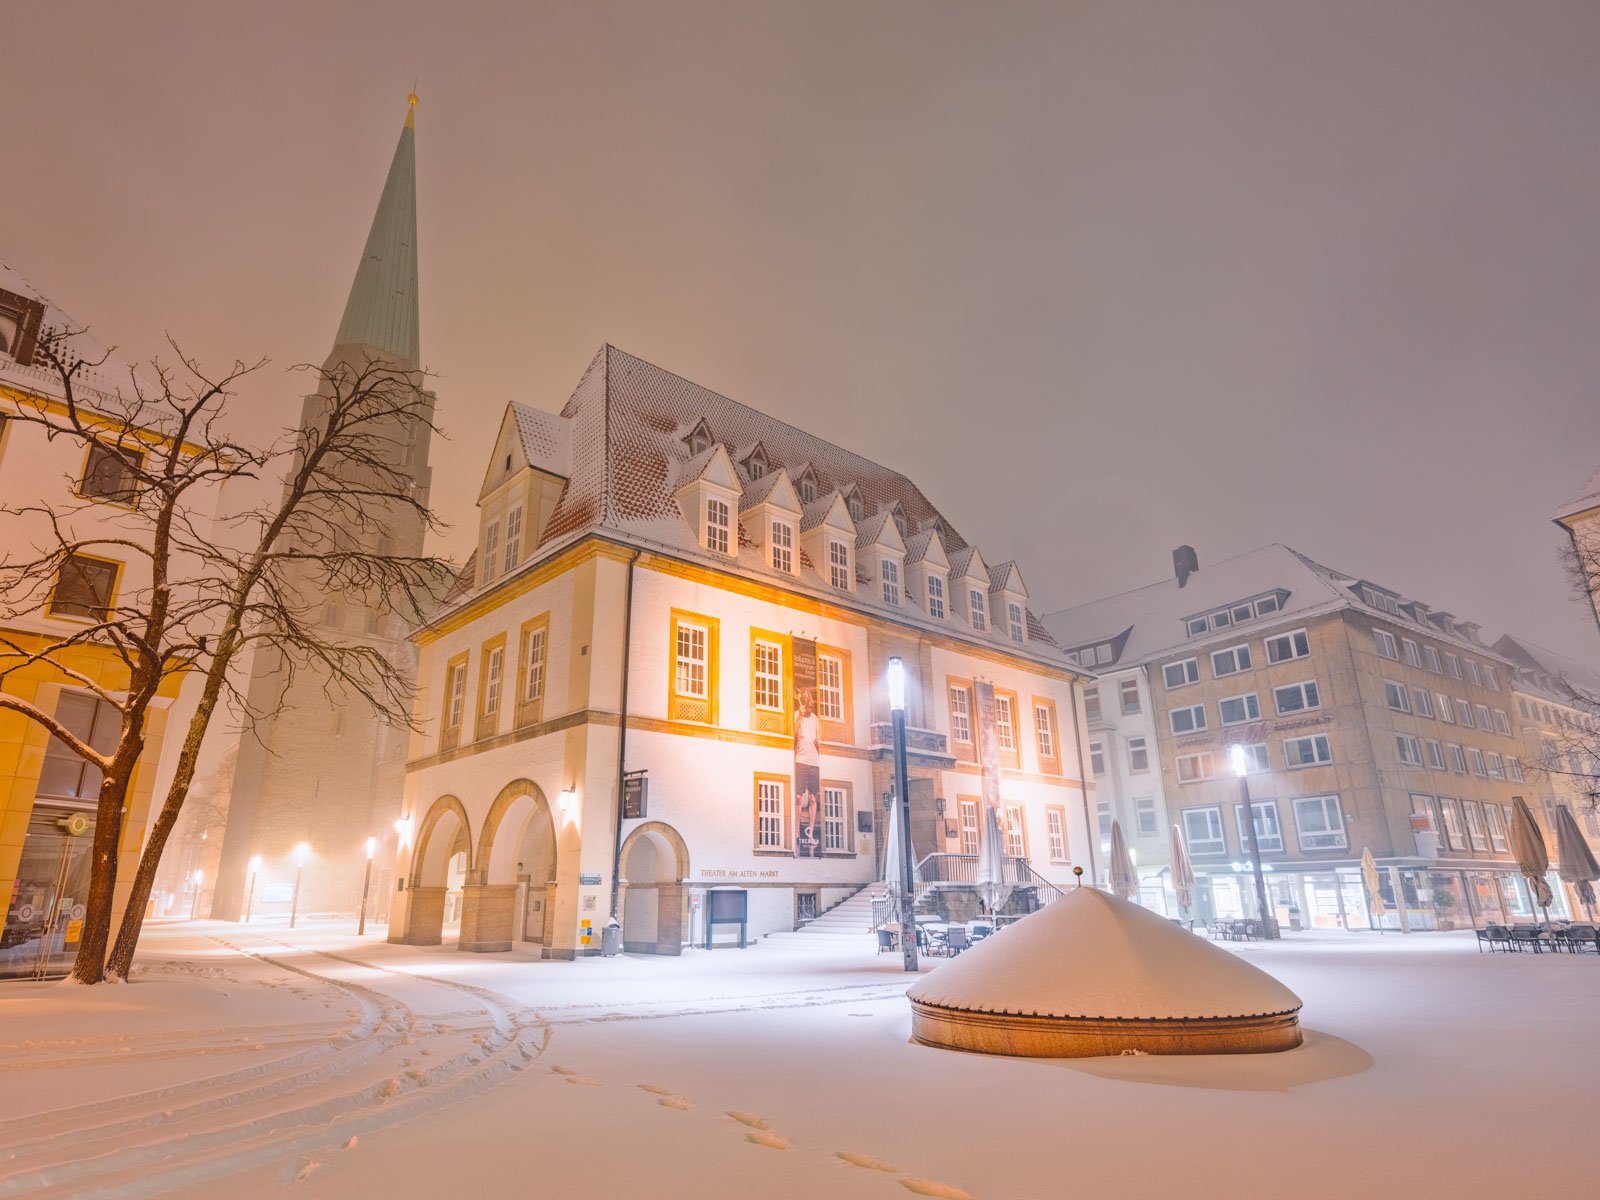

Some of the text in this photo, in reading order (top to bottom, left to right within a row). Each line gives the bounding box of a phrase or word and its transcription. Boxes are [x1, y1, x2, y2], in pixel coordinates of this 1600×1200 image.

[701, 869, 780, 878] THEATER AM ALTEN MARKT
